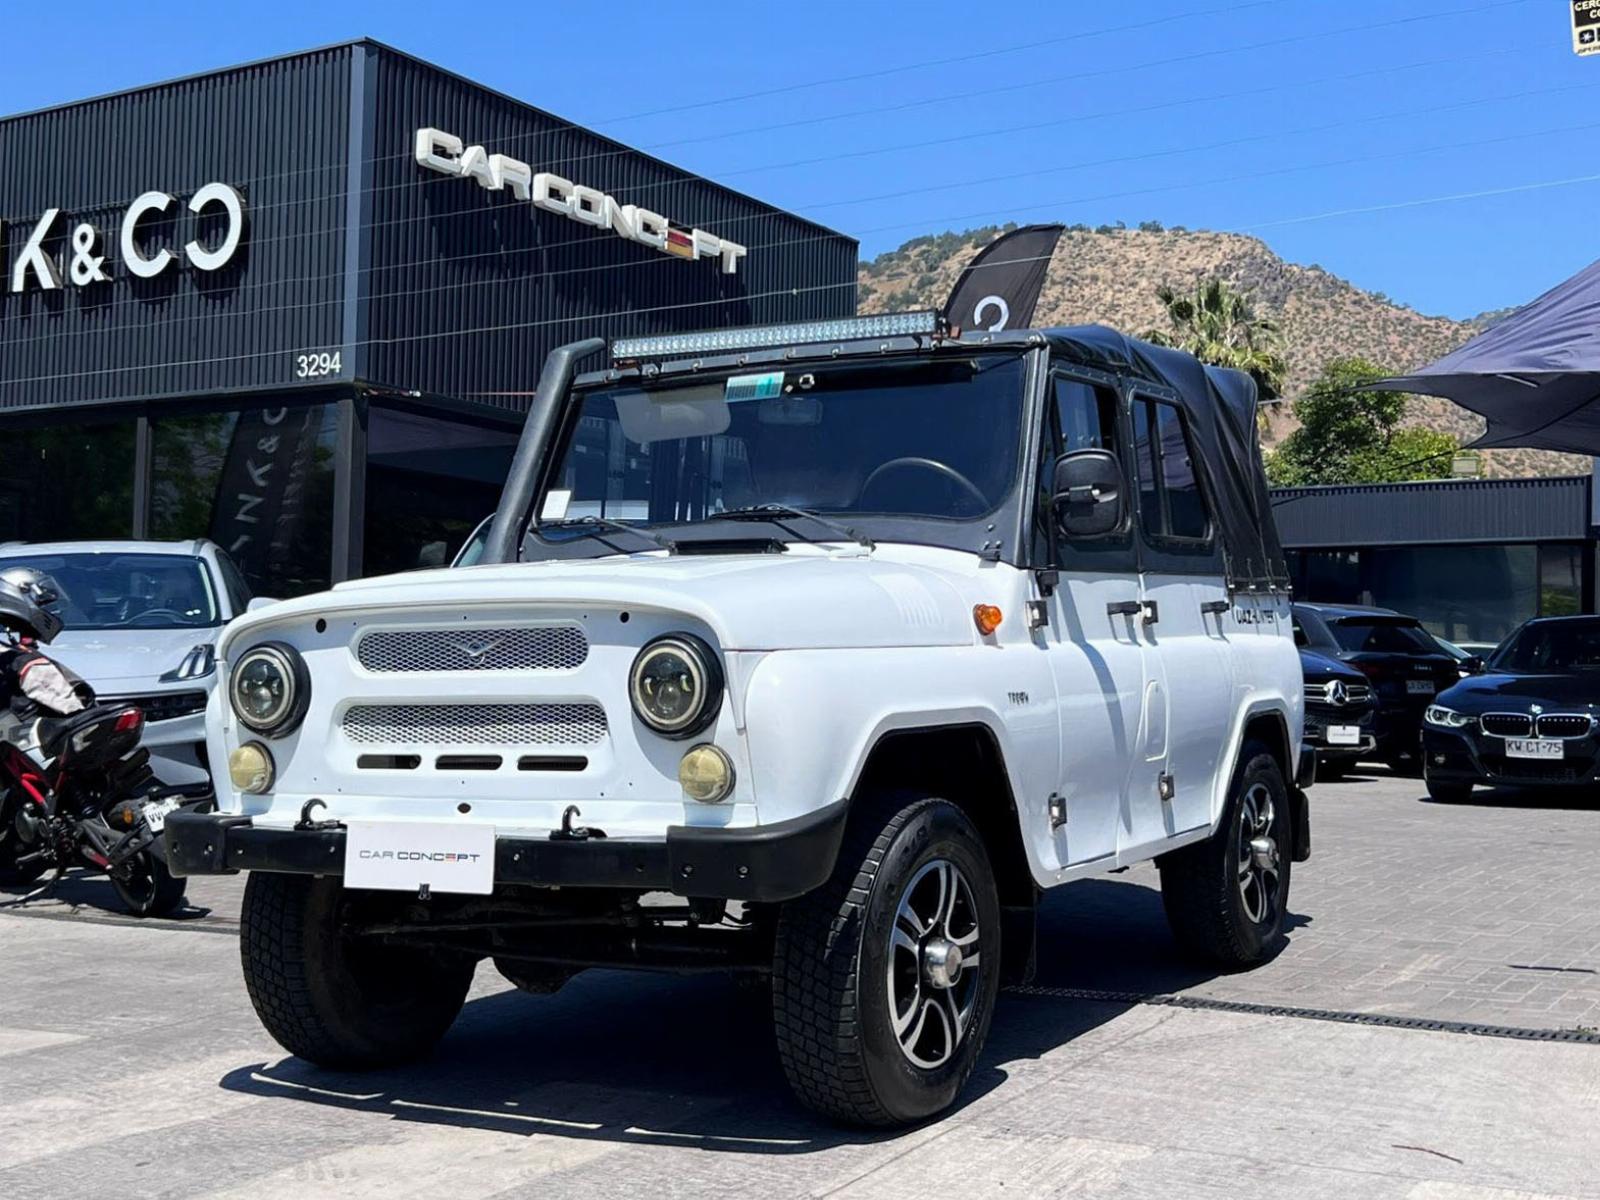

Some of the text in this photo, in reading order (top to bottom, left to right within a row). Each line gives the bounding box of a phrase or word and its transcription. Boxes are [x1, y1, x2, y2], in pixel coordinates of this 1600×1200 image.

[415, 127, 747, 274] CAR CONCEPT
[296, 351, 341, 377] 3294
[359, 850, 481, 862] CAR CONCEPT
